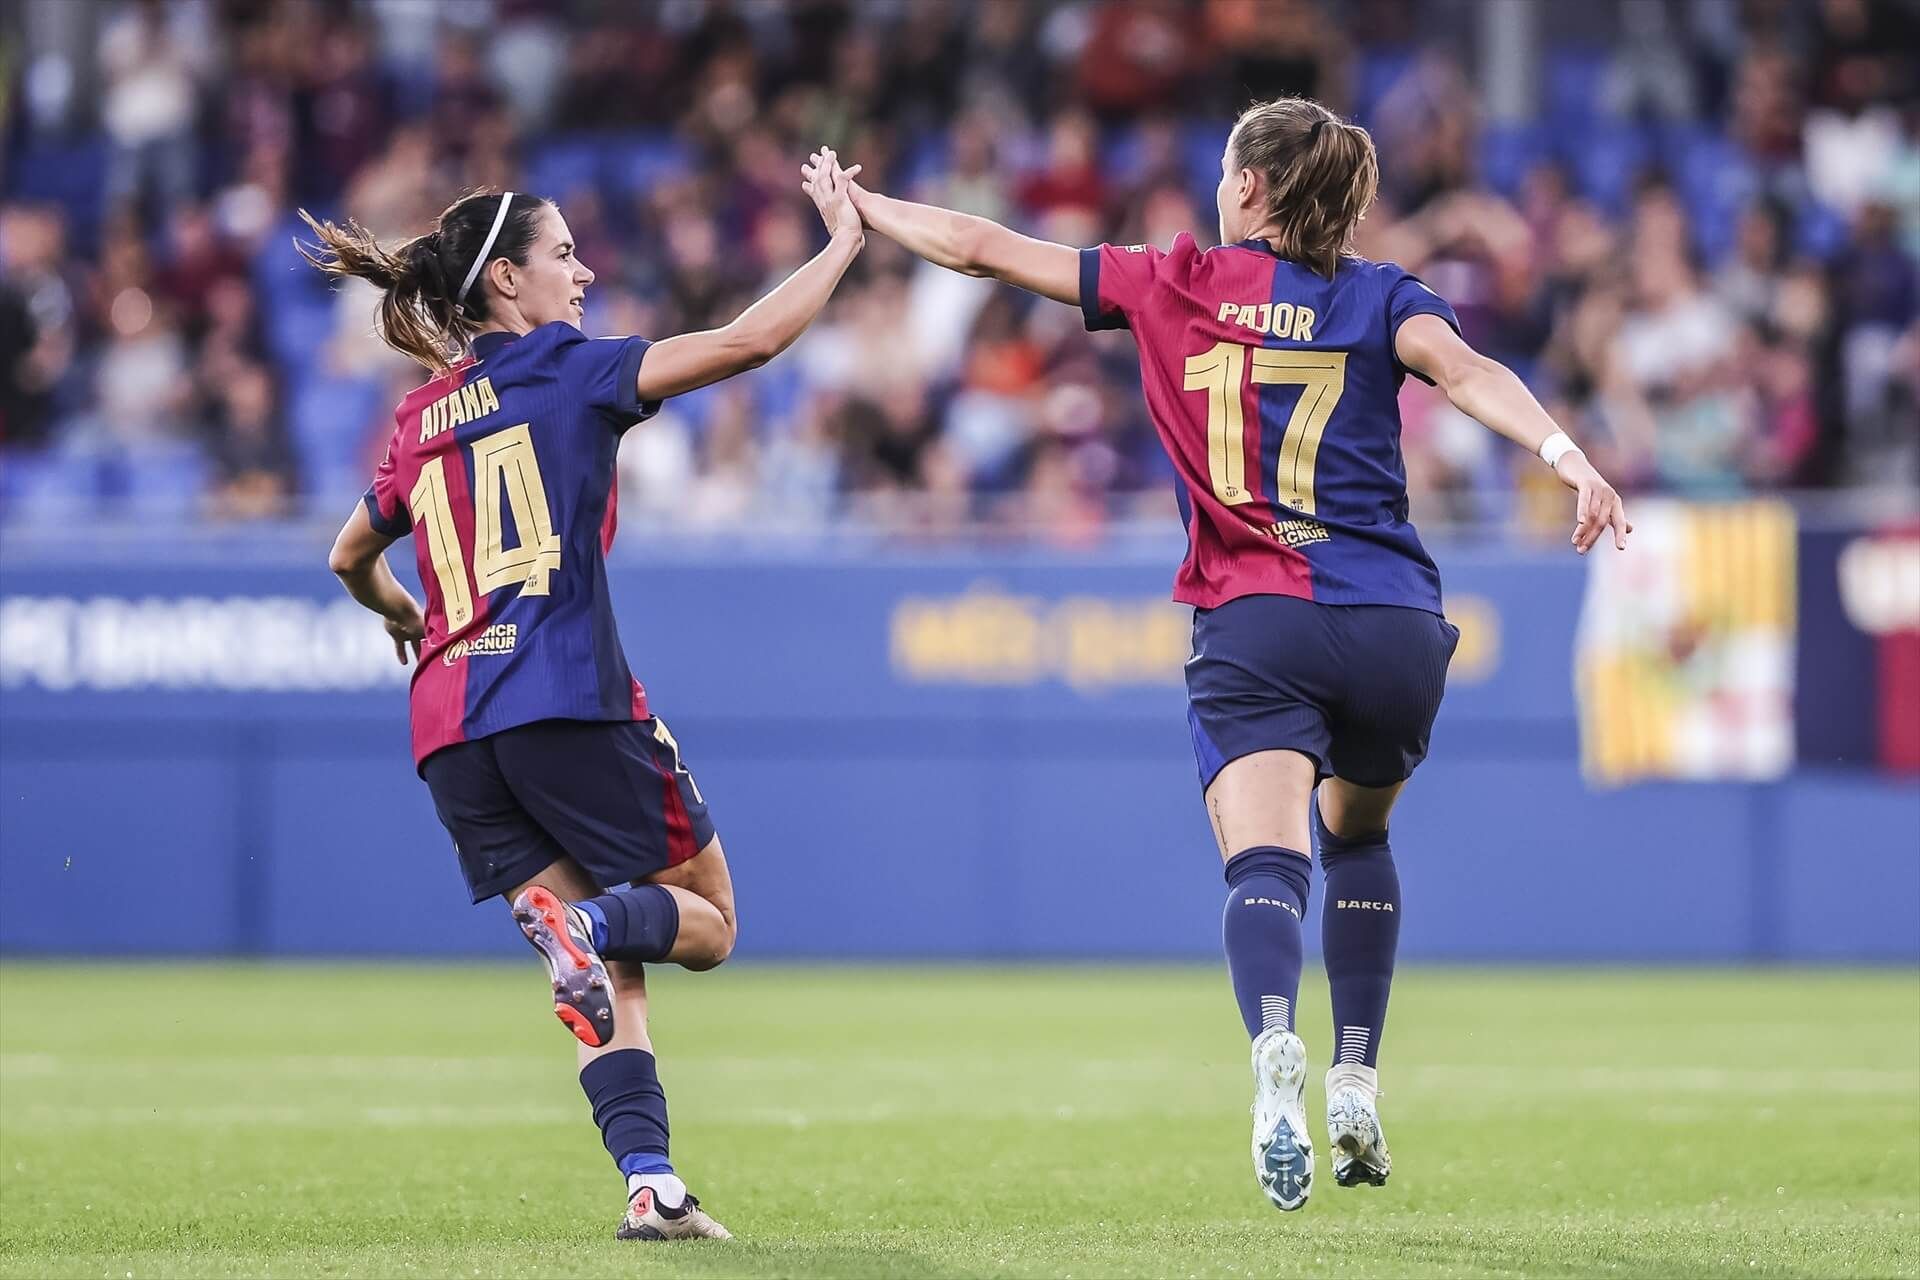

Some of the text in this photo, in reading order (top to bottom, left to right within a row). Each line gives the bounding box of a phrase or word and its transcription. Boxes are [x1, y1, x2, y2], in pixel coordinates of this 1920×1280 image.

[1217, 302, 1315, 342] PAJOR
[419, 376, 500, 444] AITANA
[1184, 342, 1349, 516] 17
[409, 423, 561, 634] 14
[1278, 527, 1329, 546] ACNUR
[481, 623, 518, 638] HCR
